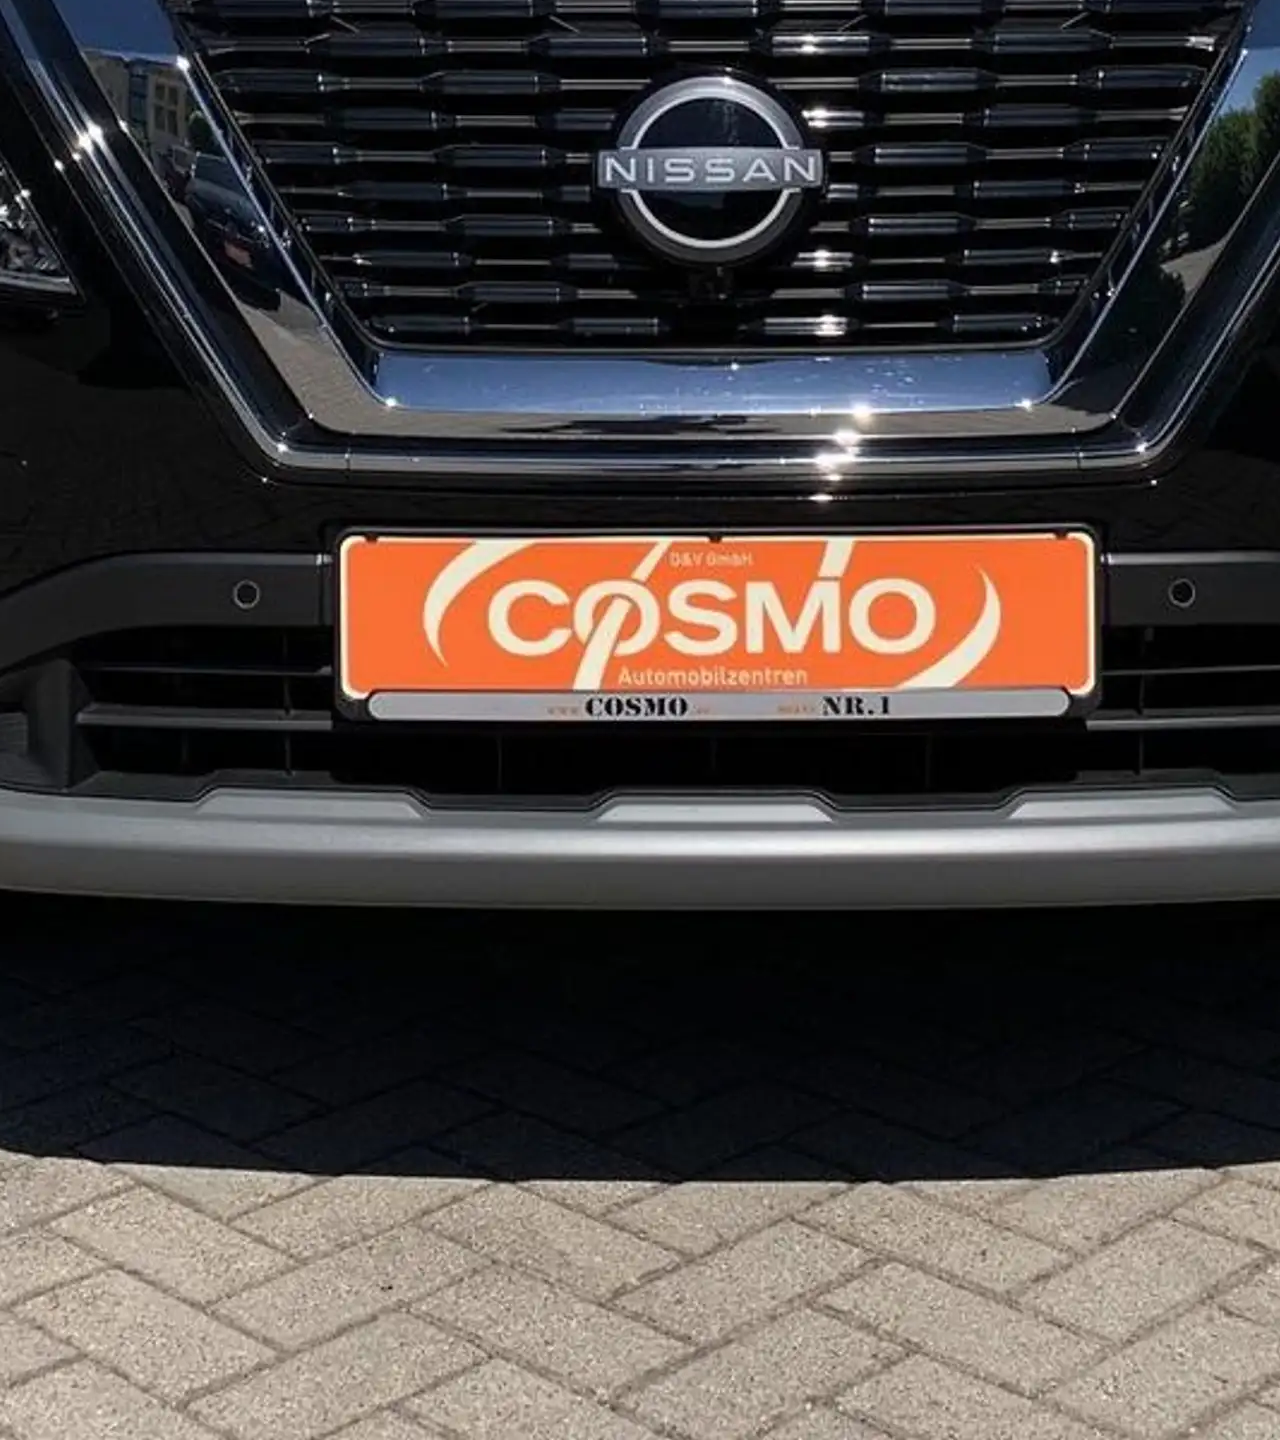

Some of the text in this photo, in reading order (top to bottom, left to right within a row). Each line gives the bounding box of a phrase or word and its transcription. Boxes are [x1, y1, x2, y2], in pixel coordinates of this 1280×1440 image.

[605, 156, 816, 184] NISSAN
[488, 578, 937, 656] COSMO
[618, 667, 808, 686] Automobilzentren
[584, 697, 689, 717] COSMO
